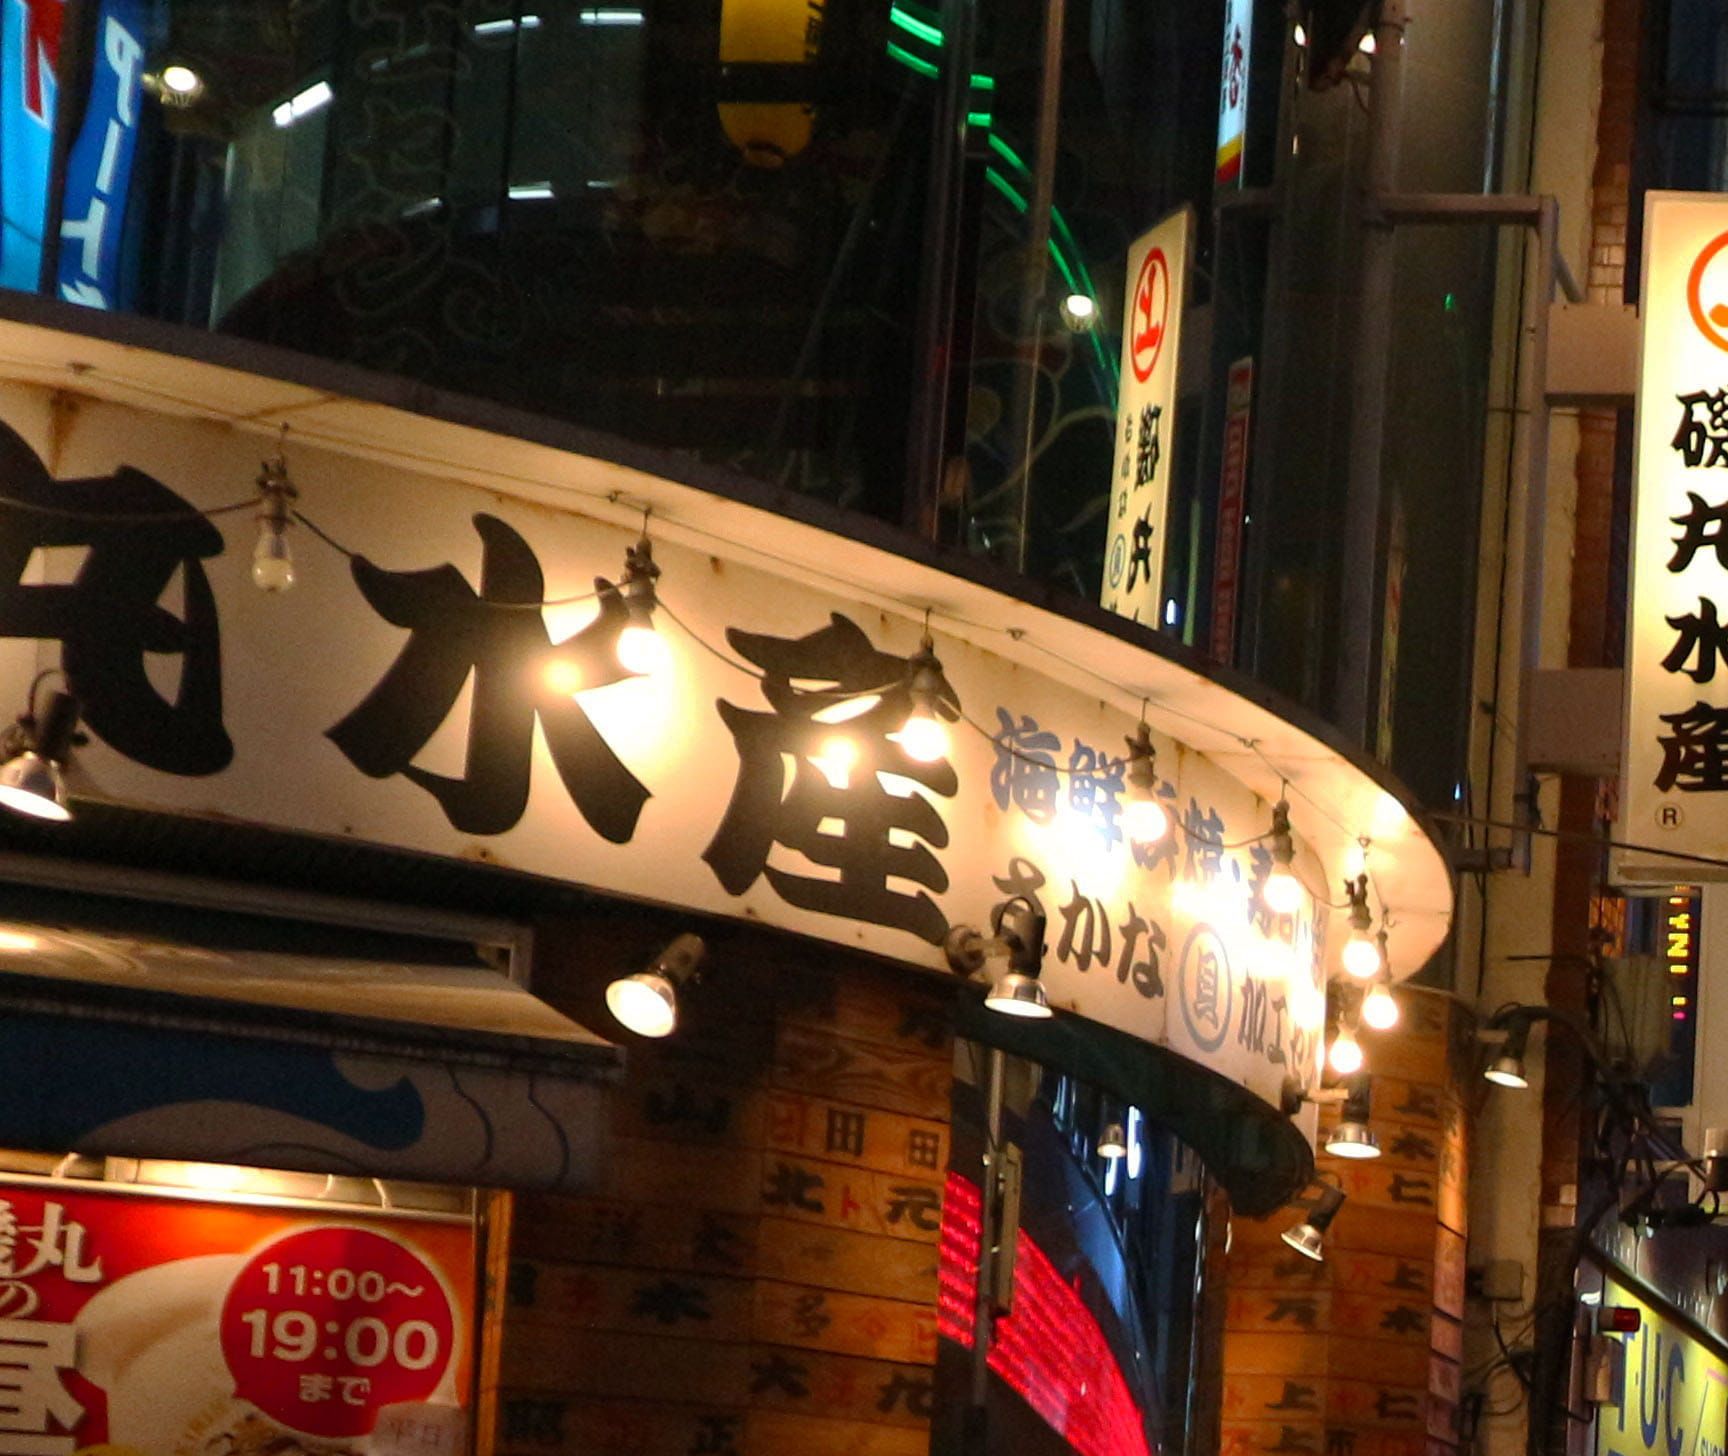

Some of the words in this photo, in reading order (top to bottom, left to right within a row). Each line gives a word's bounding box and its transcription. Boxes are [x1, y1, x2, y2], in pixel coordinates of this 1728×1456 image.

[0, 1200, 103, 1283] 丸
[241, 1308, 439, 1371] 19:00
[299, 1374, 371, 1406] まで
